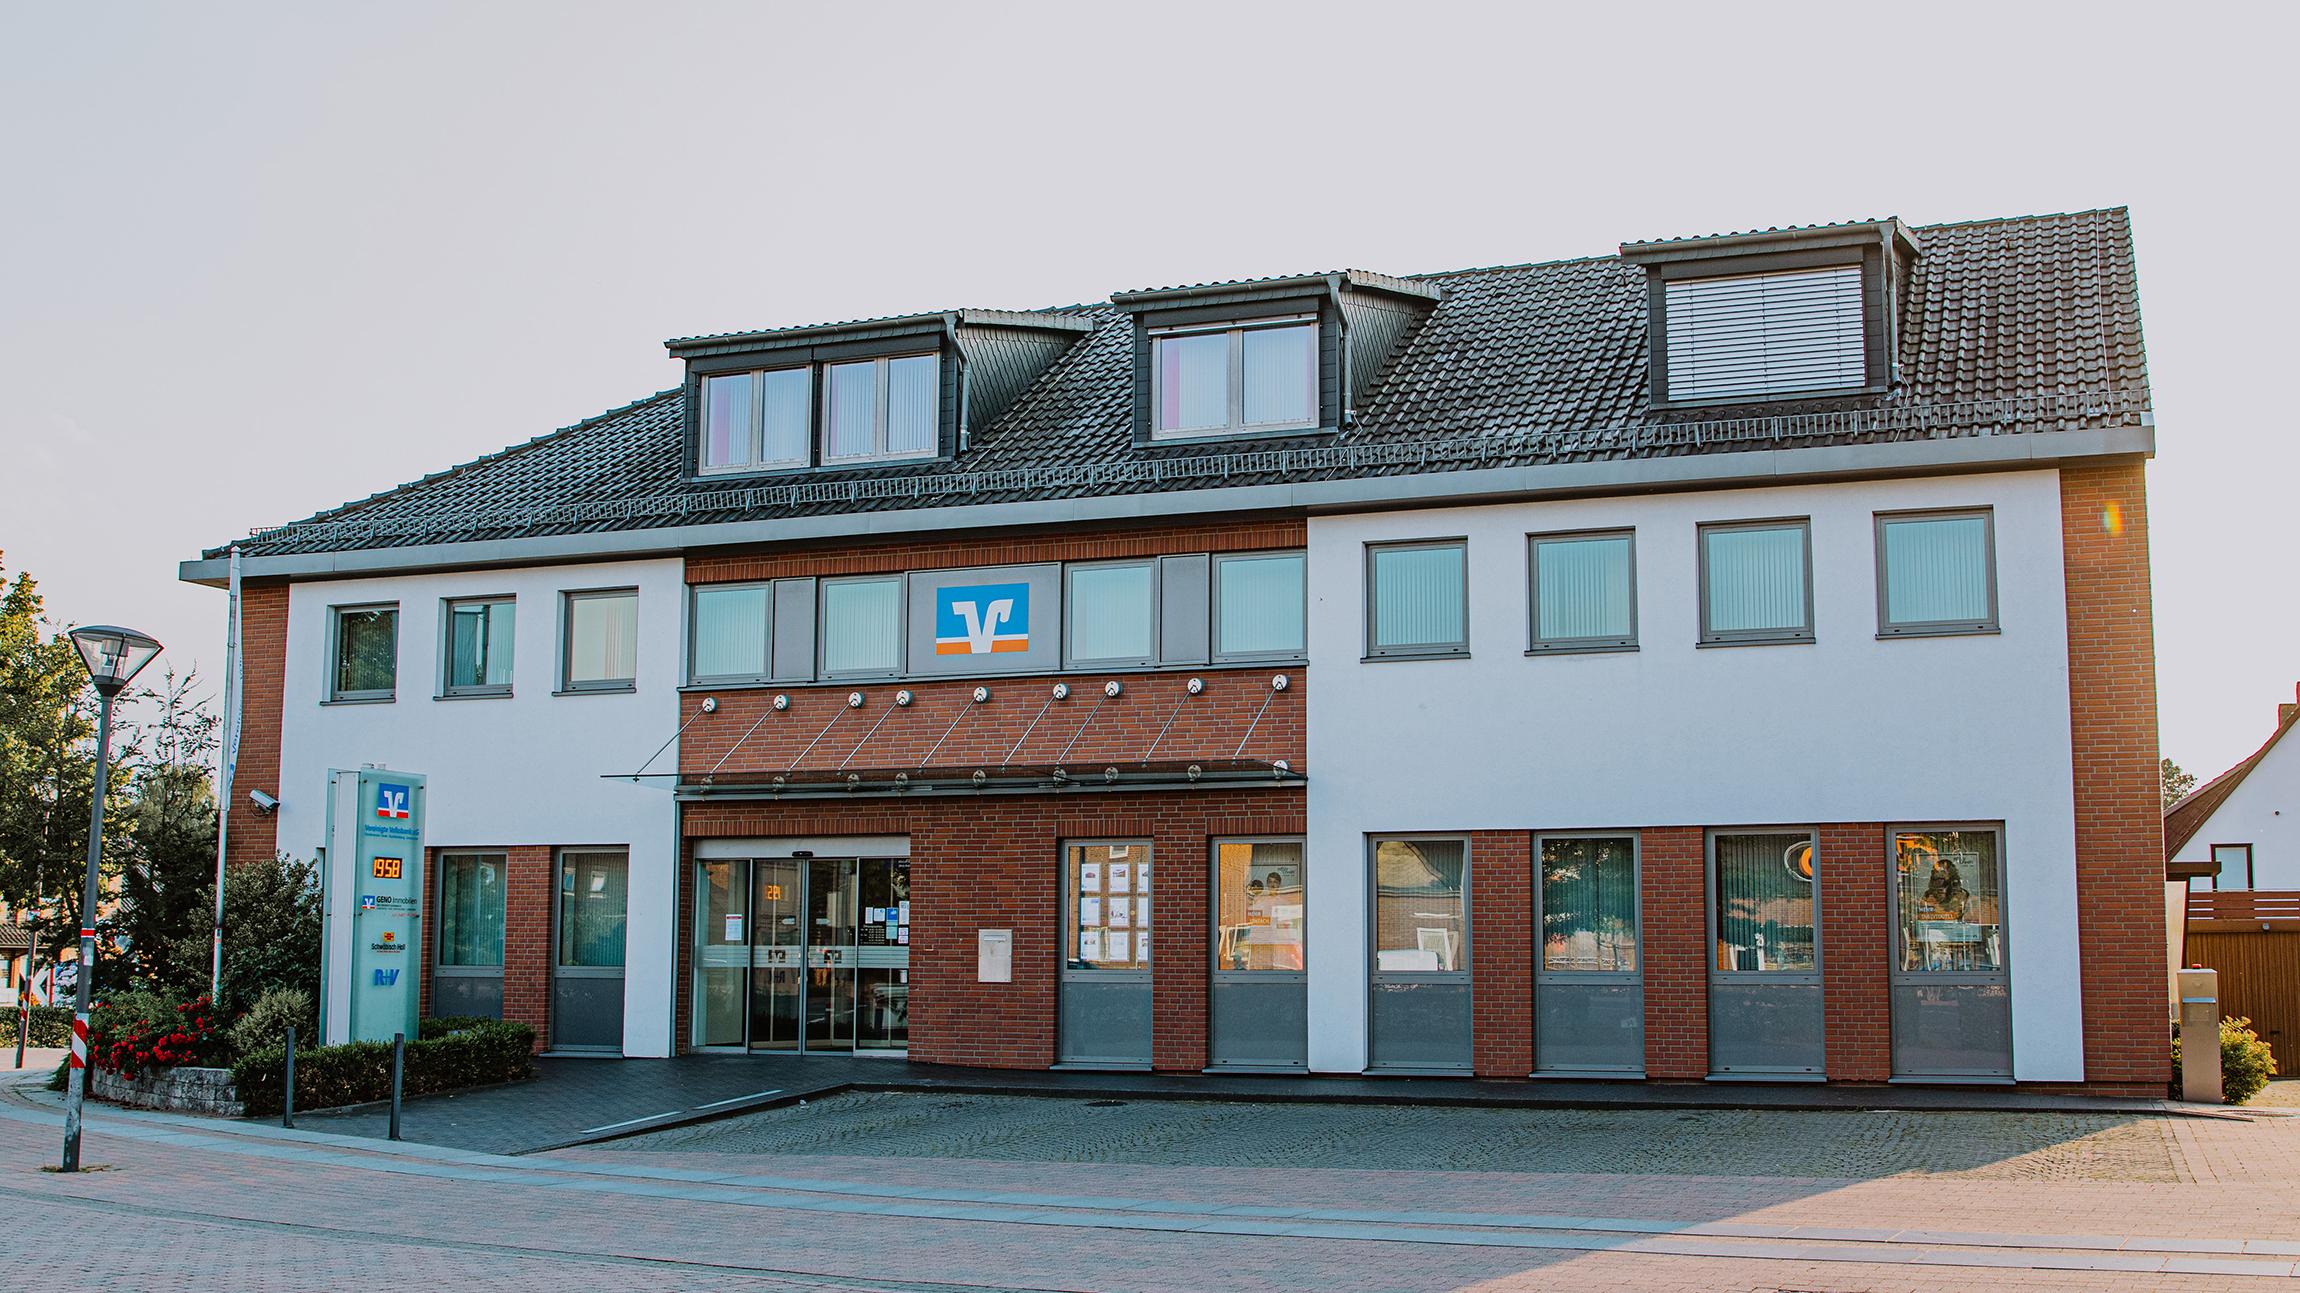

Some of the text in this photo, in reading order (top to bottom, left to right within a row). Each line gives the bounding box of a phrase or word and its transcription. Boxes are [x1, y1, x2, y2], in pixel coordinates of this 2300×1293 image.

[376, 895, 418, 905] GENO Immobilien
[374, 969, 400, 986] R+V
